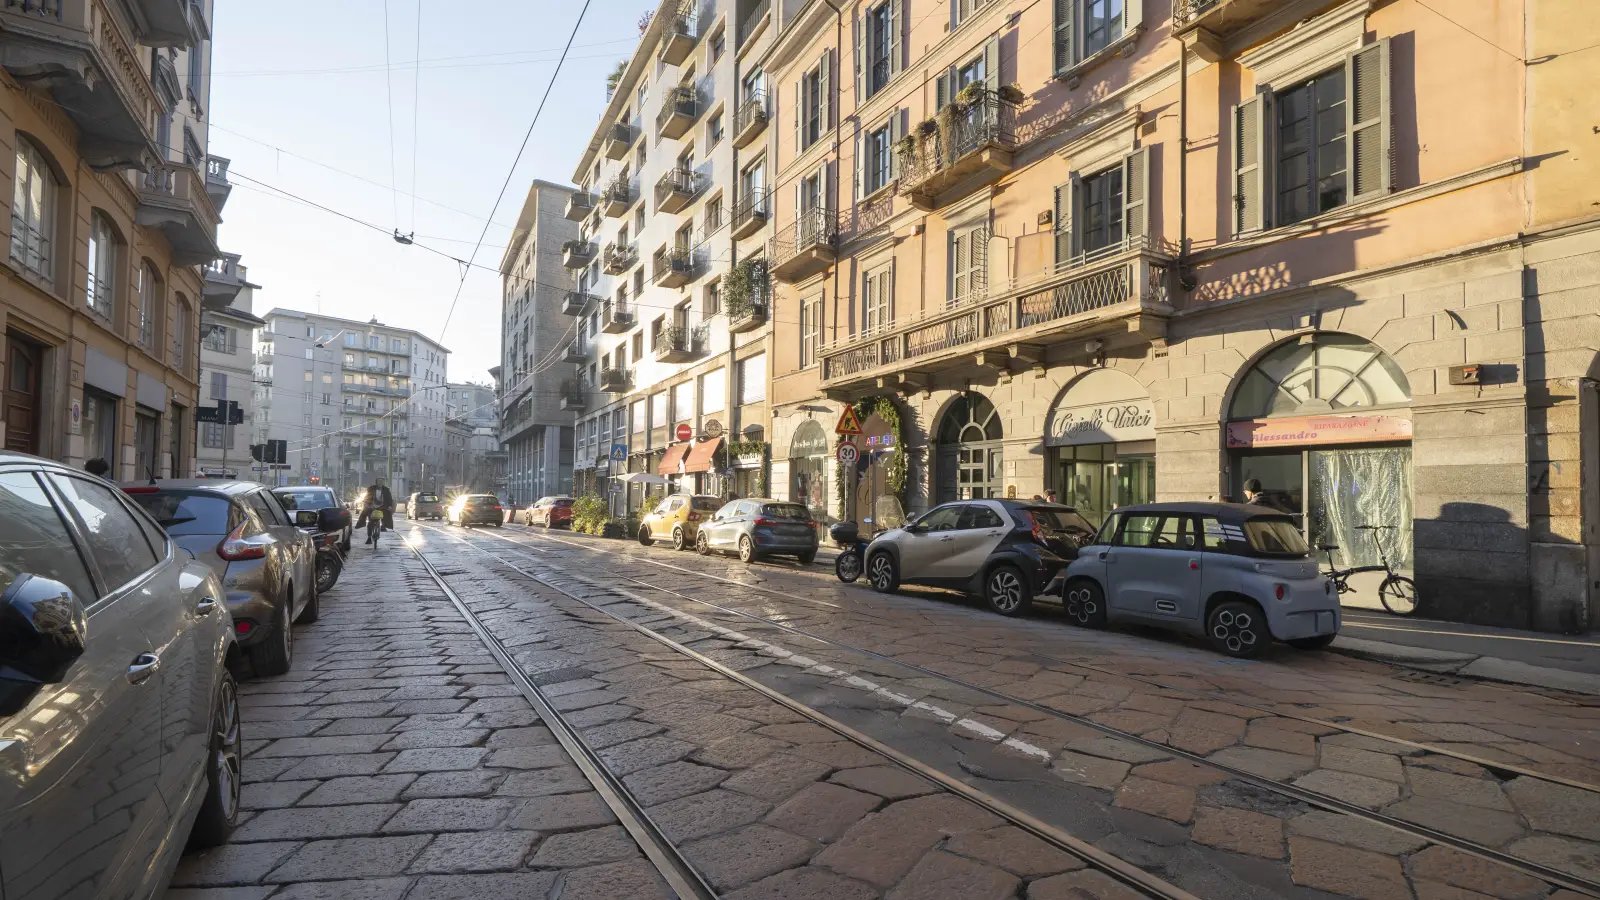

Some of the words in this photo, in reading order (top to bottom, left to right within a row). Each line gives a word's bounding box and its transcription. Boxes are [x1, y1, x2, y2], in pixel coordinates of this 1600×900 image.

[1053, 408, 1104, 443] Gioielli
[1106, 405, 1151, 429] Unici
[1252, 430, 1318, 442] Alessandro
[841, 447, 855, 460] 30
